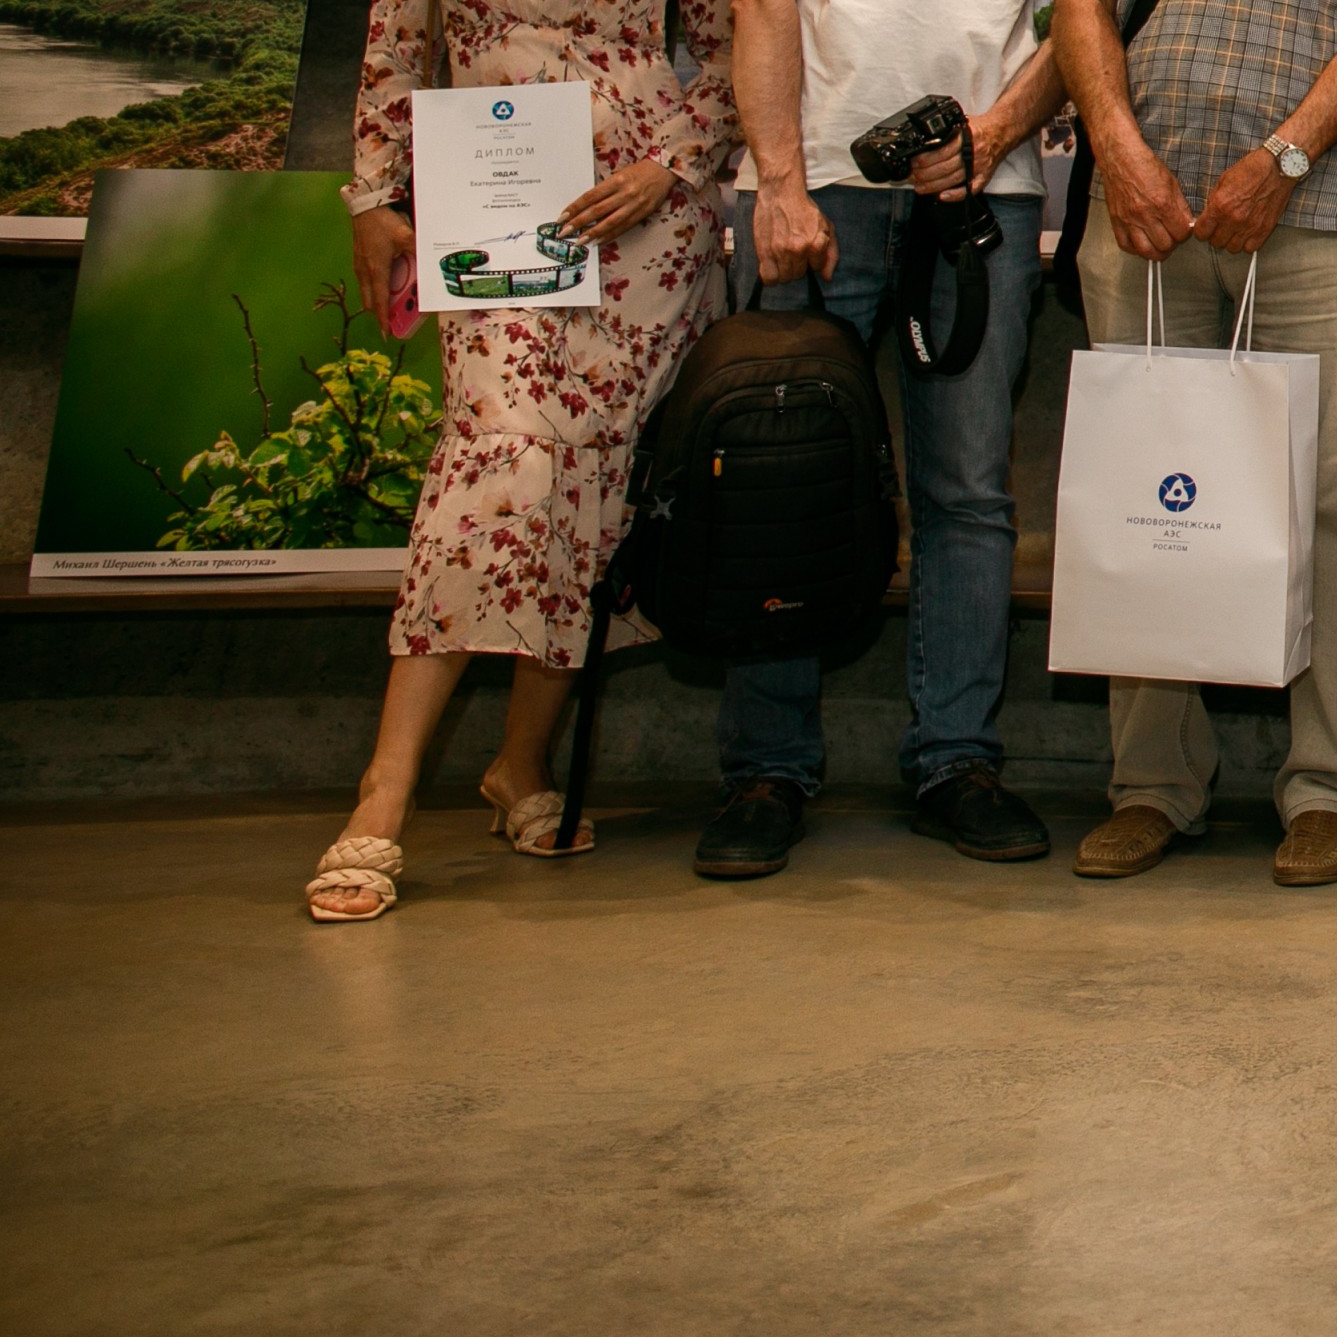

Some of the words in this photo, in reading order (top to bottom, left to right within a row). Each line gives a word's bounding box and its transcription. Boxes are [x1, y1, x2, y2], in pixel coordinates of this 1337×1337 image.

[474, 147, 535, 159] ДИПЛОМ
[492, 170, 519, 178] ОВДАК
[910, 320, 931, 363] OLYMPUS
[1126, 516, 1222, 531] НОВОВОРОНЕЖСКАЯ
[1163, 530, 1181, 539] АЭС
[1153, 543, 1188, 552] РОСАТОМ
[52, 559, 100, 570] Михаил
[102, 559, 157, 571] Шершень
[160, 558, 210, 569] «Желтая
[211, 558, 277, 569] трясогузка»
